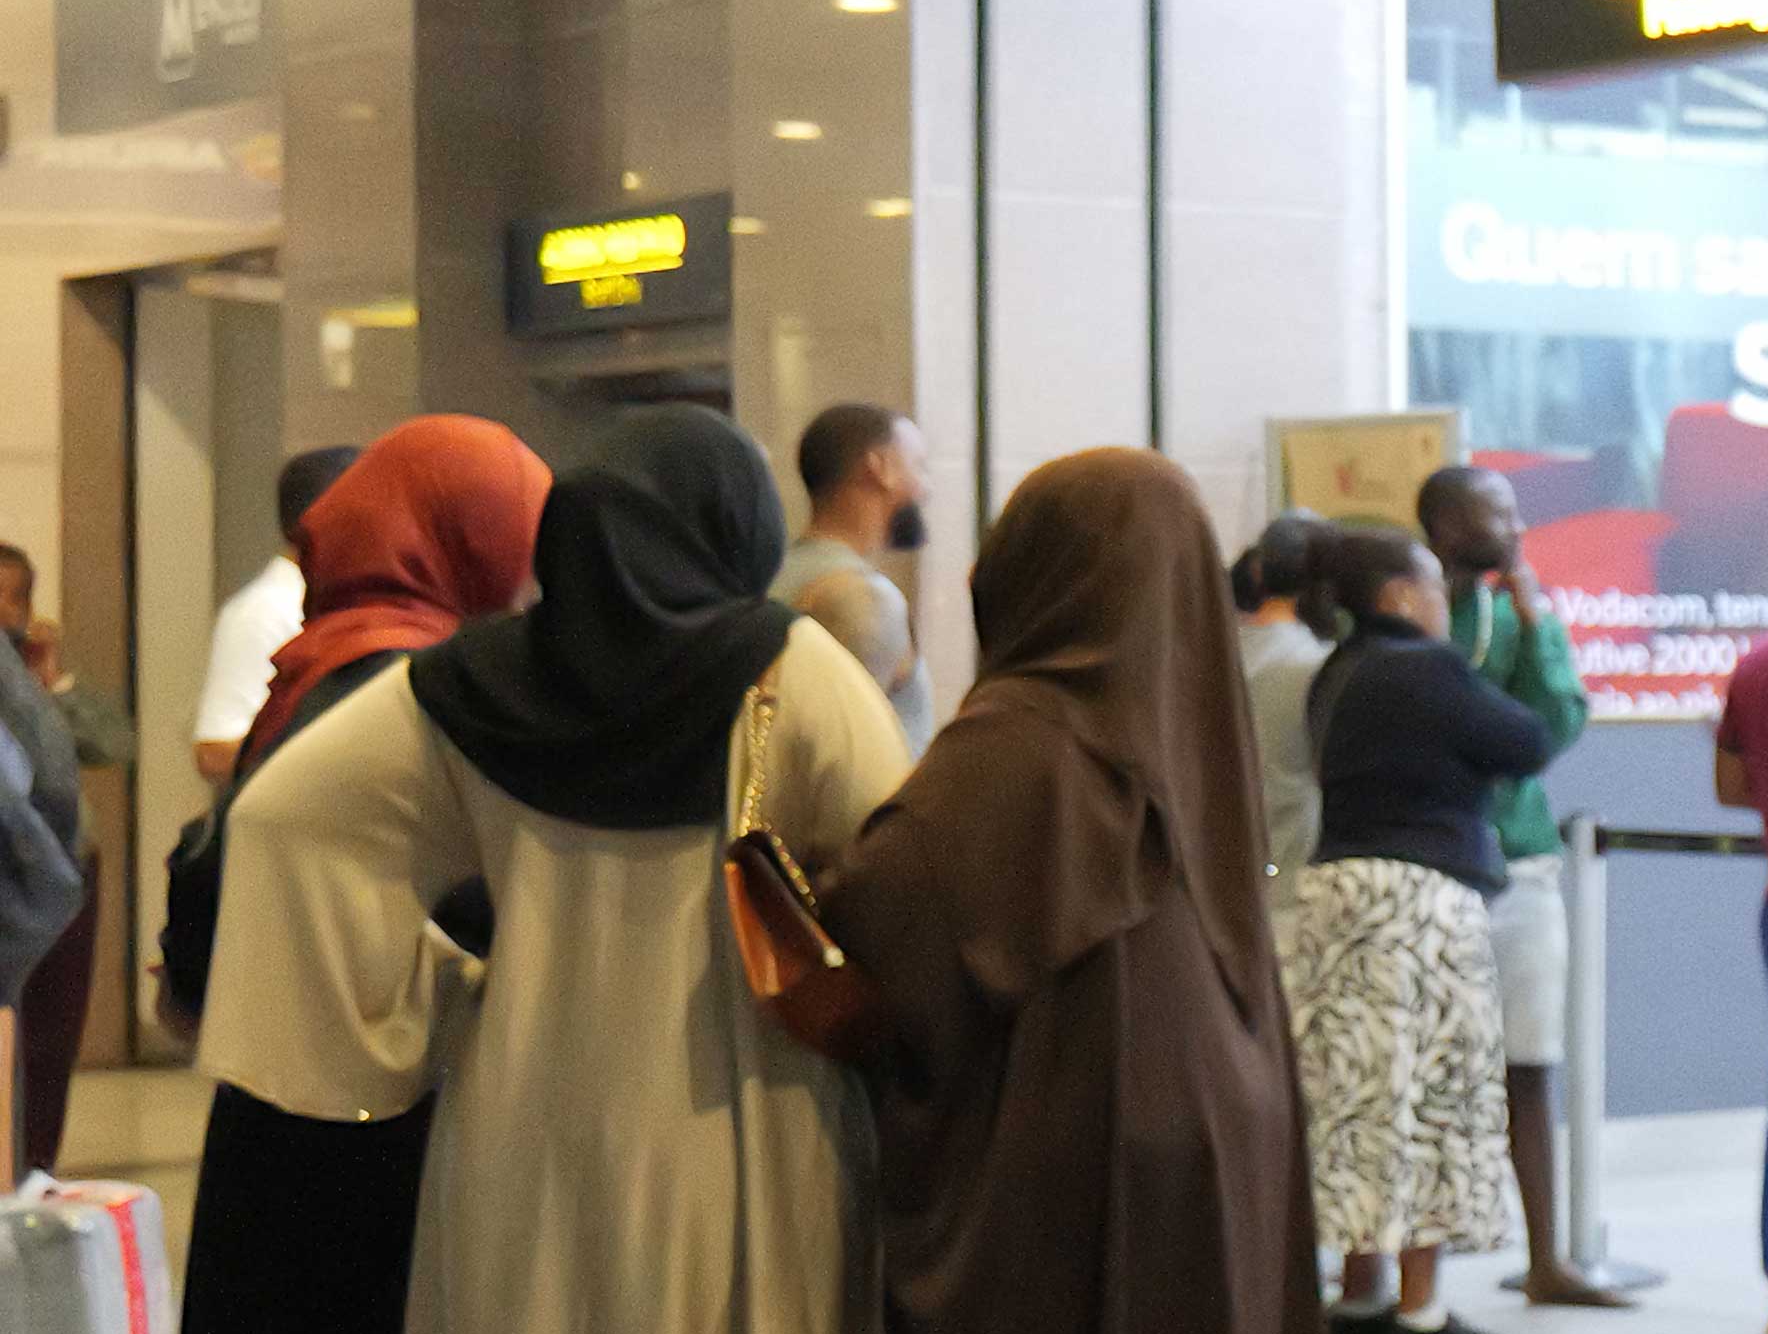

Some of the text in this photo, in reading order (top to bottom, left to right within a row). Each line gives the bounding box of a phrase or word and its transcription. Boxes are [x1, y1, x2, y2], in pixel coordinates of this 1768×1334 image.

[1442, 201, 1681, 291] Quem
[1550, 586, 1714, 629] Vodacom,
[1650, 632, 1737, 677] 2000
